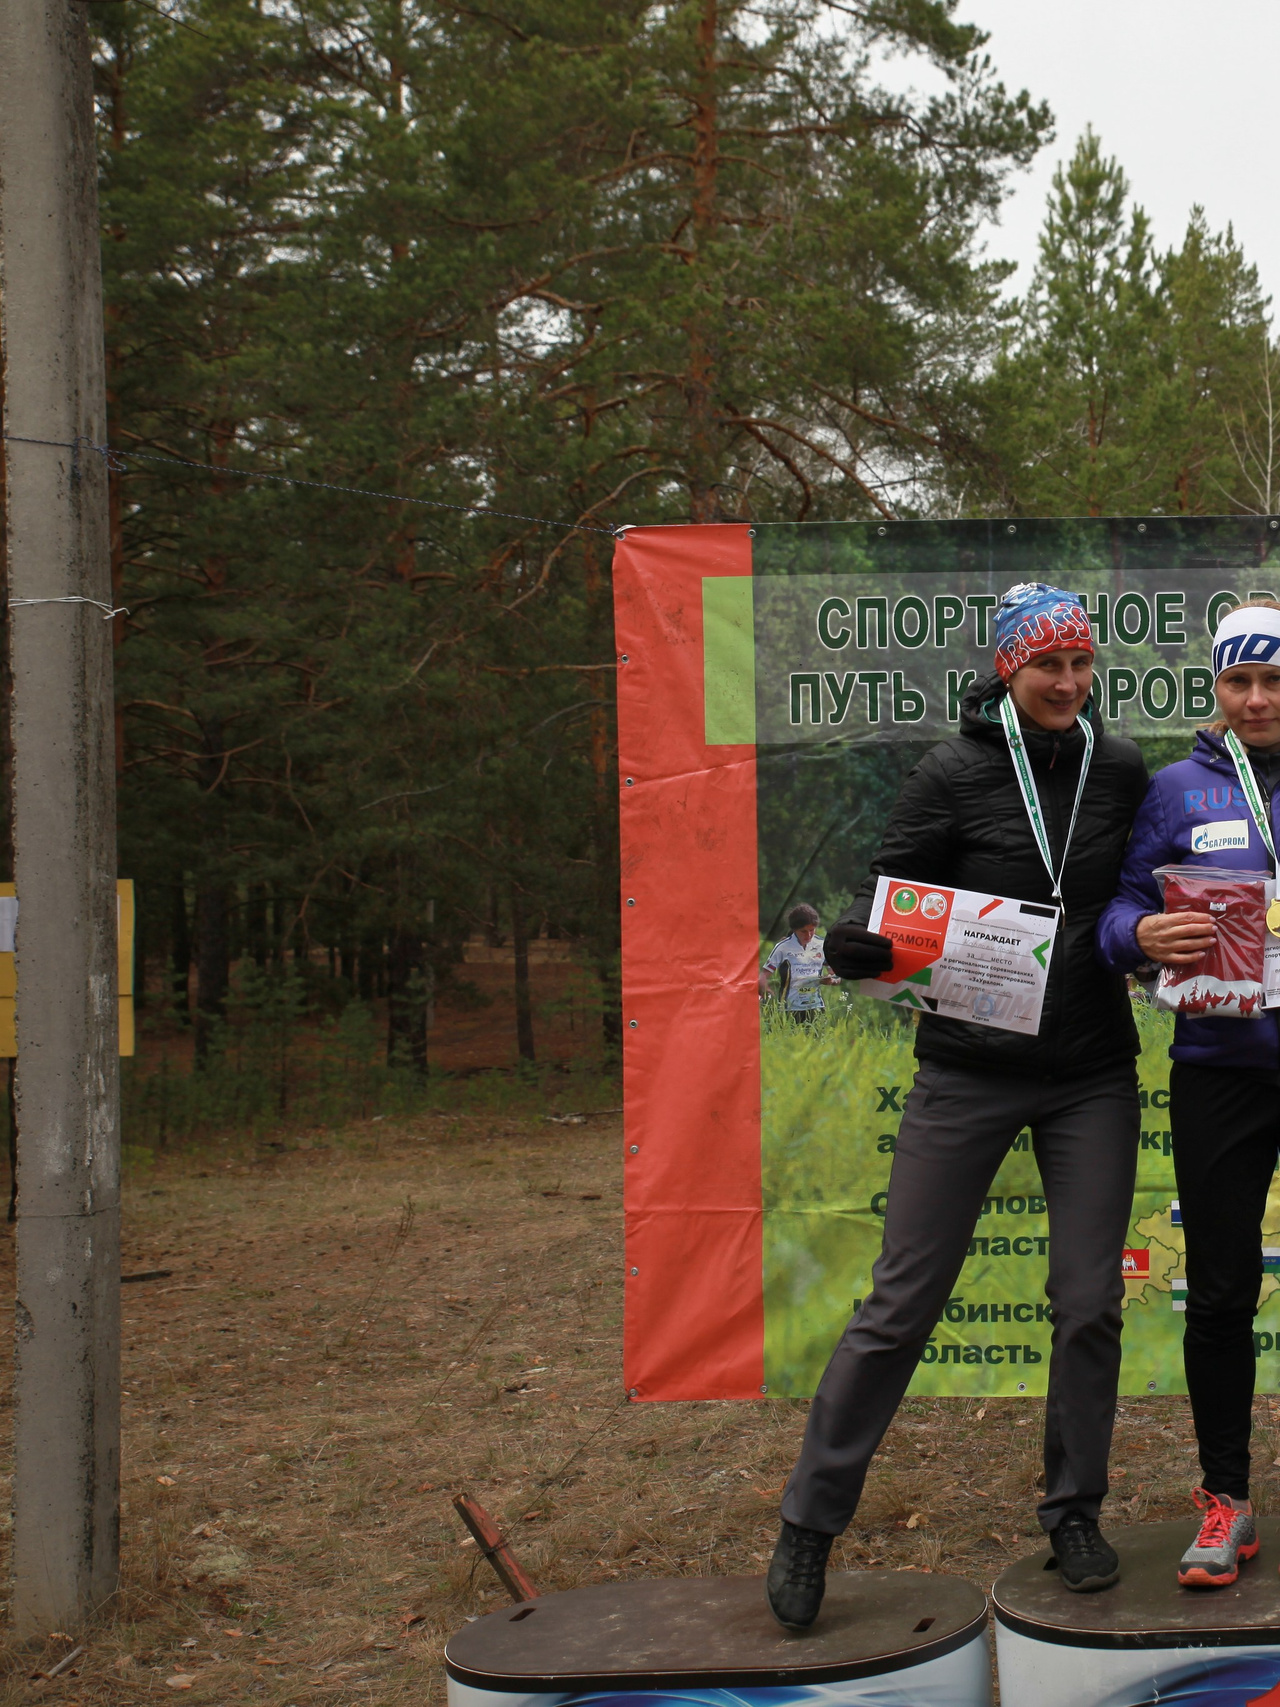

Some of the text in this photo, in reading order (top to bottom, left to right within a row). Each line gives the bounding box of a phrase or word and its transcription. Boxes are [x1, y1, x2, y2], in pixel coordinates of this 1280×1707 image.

[817, 592, 1185, 650] СПОРТНОЕ
[789, 671, 926, 725] ПУТЬ
[1208, 836, 1246, 849] GAZPROM
[885, 931, 938, 949] ГРАМОТА
[964, 930, 1021, 946] НАГРАЖДАЕТ
[991, 957, 1013, 966] место
[919, 1337, 1042, 1364] бласть
